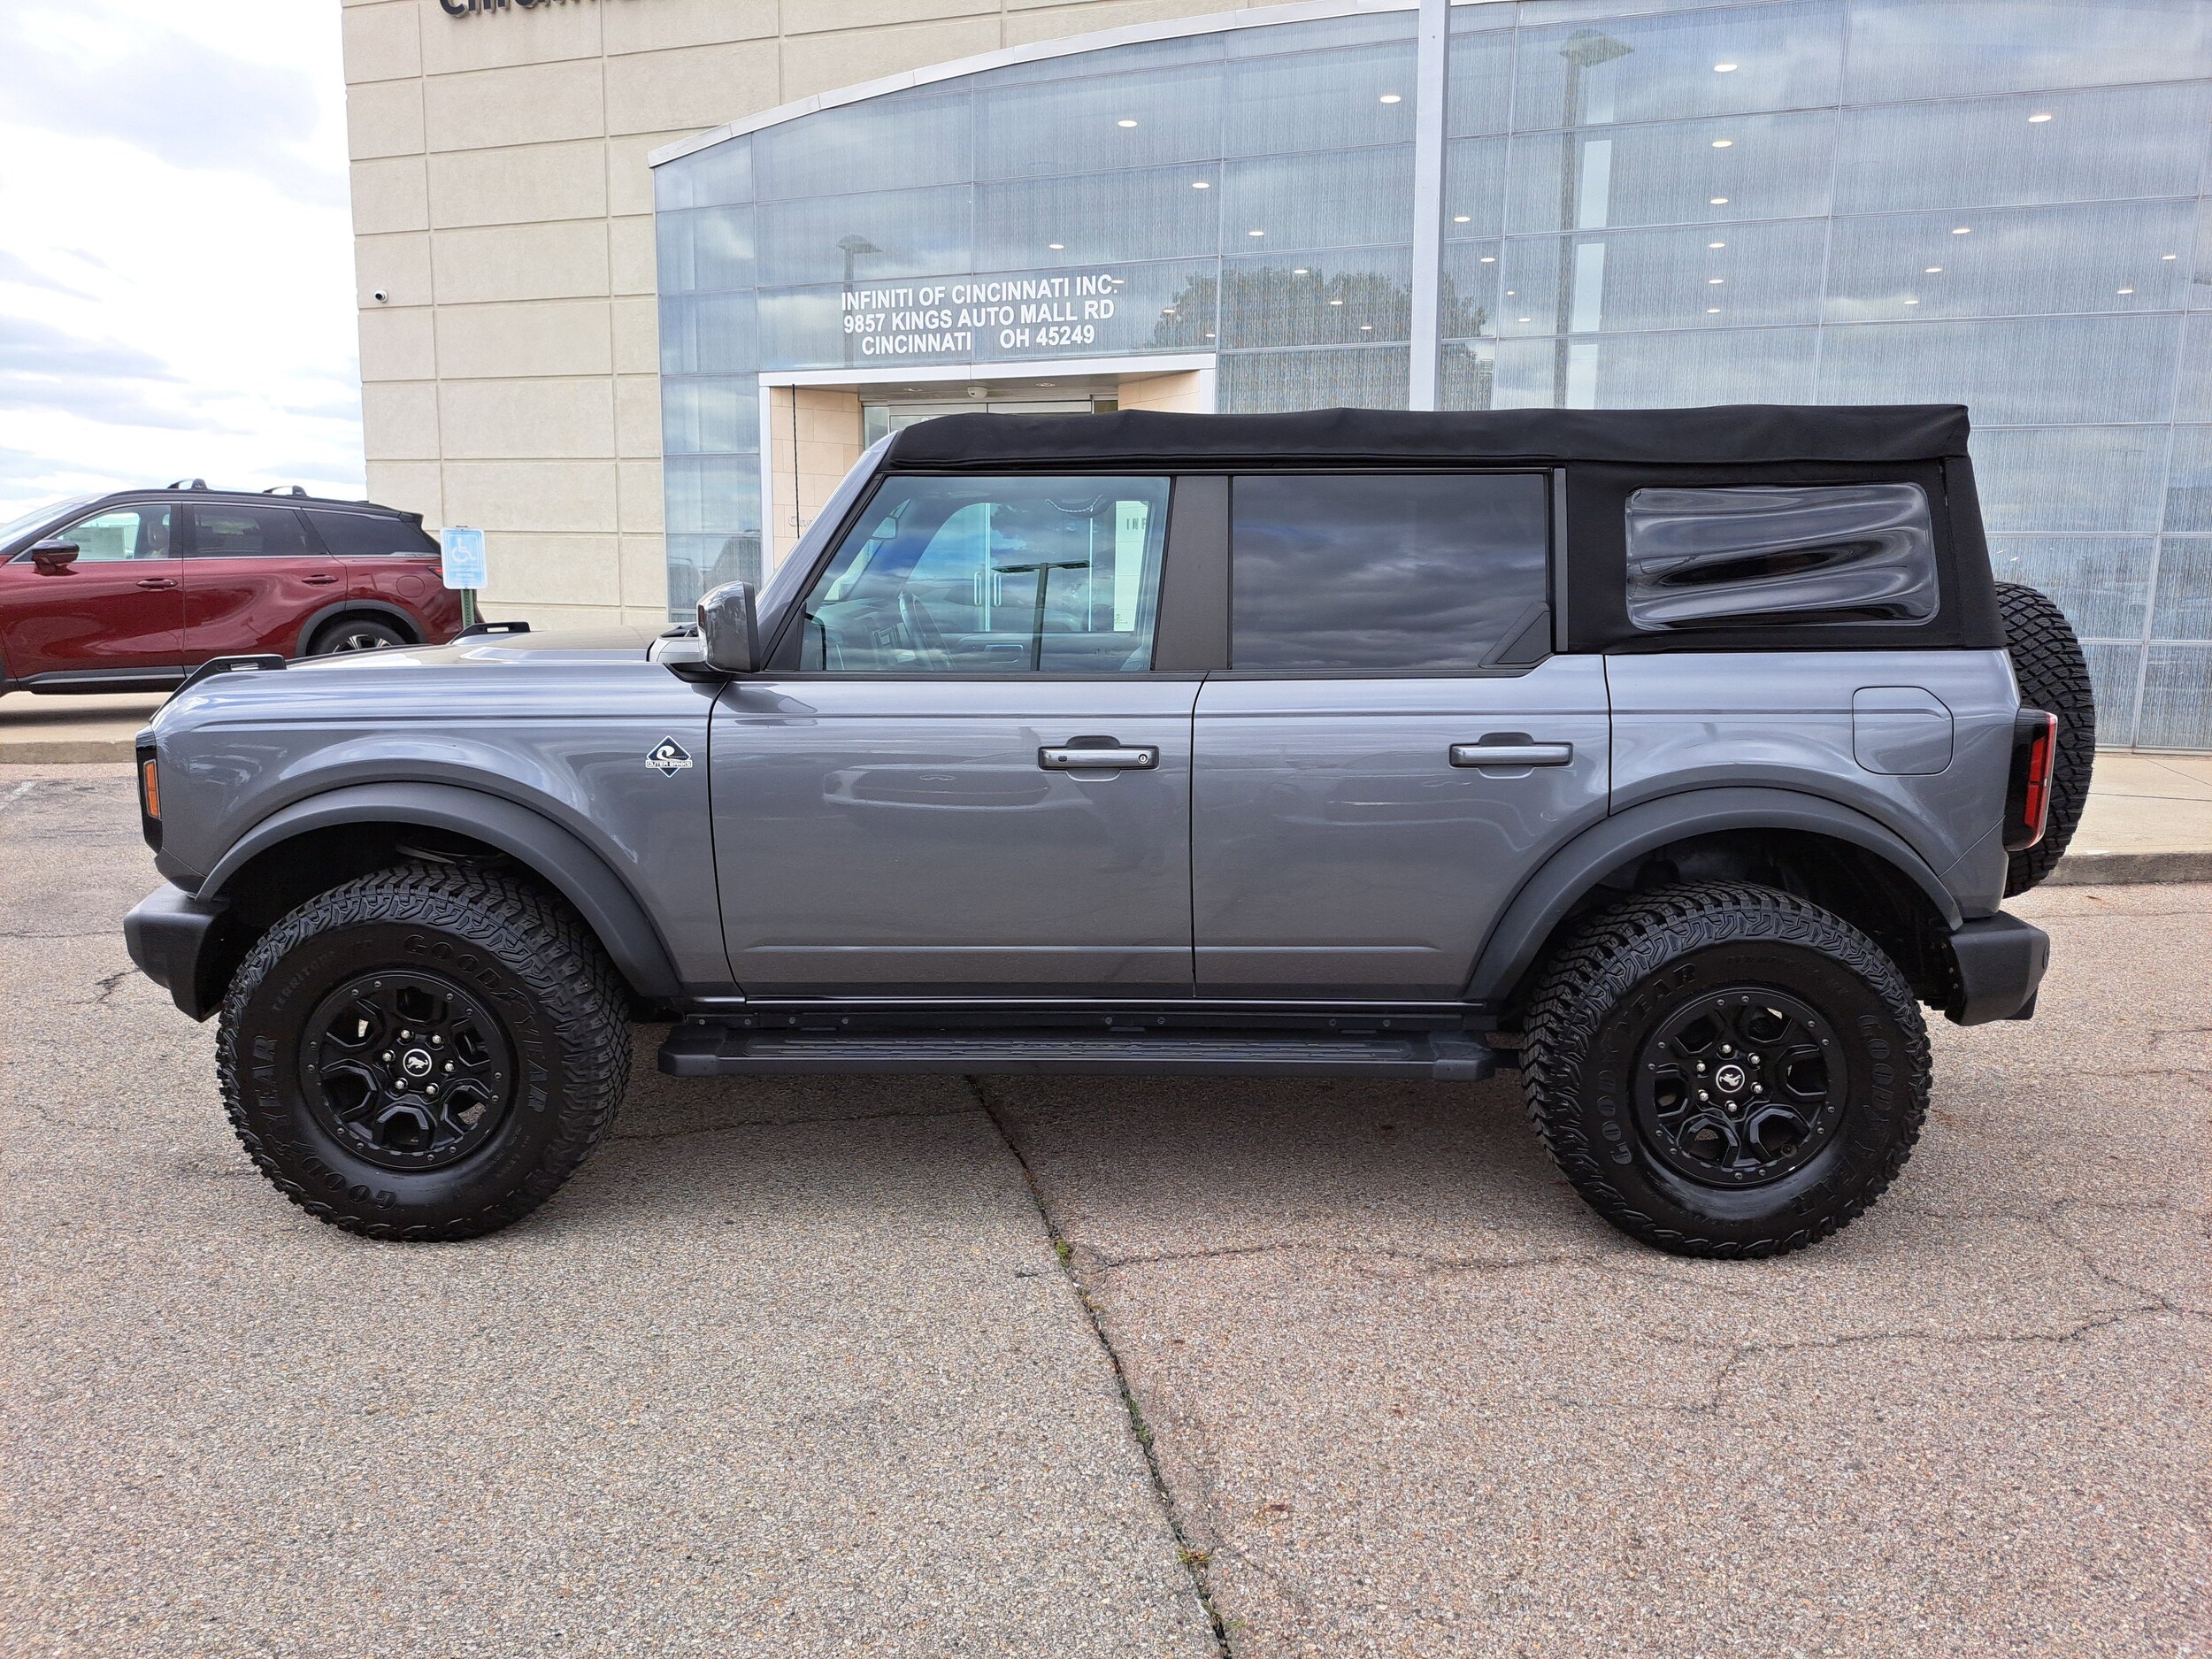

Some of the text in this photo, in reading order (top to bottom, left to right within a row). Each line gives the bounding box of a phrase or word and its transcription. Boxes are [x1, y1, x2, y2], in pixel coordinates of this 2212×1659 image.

[841, 273, 1118, 311] INFINITI OF CINCINNATI INC.
[843, 299, 1115, 334] 9857 KINGS AUTO MALL RD
[862, 324, 1095, 355] CINCINNATI OH 45249
